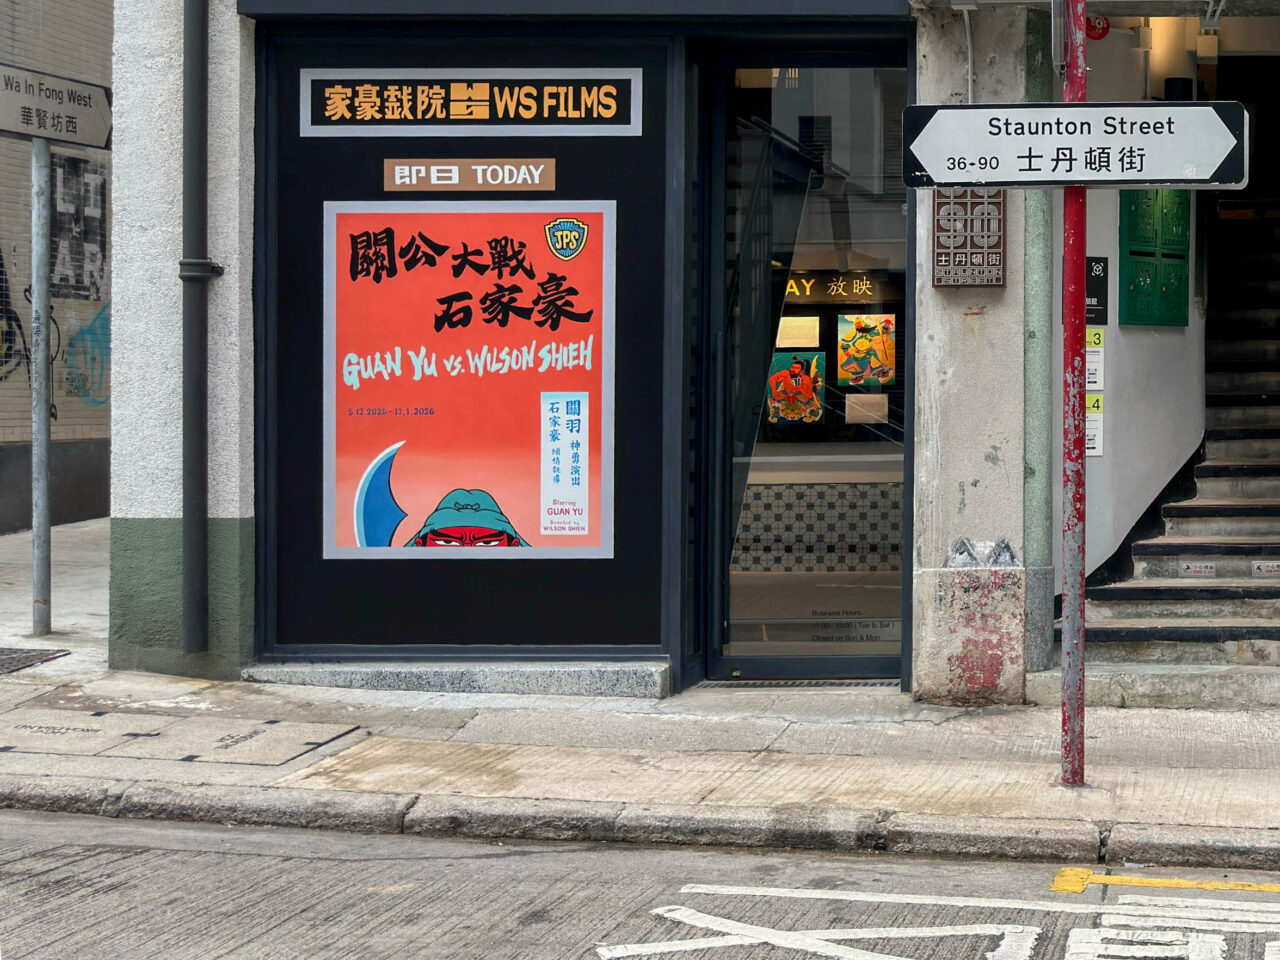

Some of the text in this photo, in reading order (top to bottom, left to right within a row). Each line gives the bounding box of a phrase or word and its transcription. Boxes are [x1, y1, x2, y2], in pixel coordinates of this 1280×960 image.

[3, 74, 93, 108] Wa In Fong West
[493, 85, 537, 119] WS
[543, 84, 618, 119] FILMS
[20, 105, 78, 135] 華賢坊西
[988, 116, 1175, 136] Staunton Street
[394, 164, 545, 185] 即日 TODAY
[1017, 146, 1146, 173] 士丹頓街
[349, 226, 536, 284] 關公大戰
[554, 230, 580, 250] JPS
[936, 253, 1001, 267] 士丹頓街
[826, 275, 873, 297] 放映
[433, 272, 594, 333] 石家豪
[343, 346, 402, 390] GUAN
[407, 345, 438, 381] YU
[465, 340, 537, 377] WILSON
[537, 334, 594, 373] SHIEH
[549, 401, 561, 442] 石家豪
[566, 399, 582, 434] 關羽
[547, 508, 584, 516] GUAN YU
